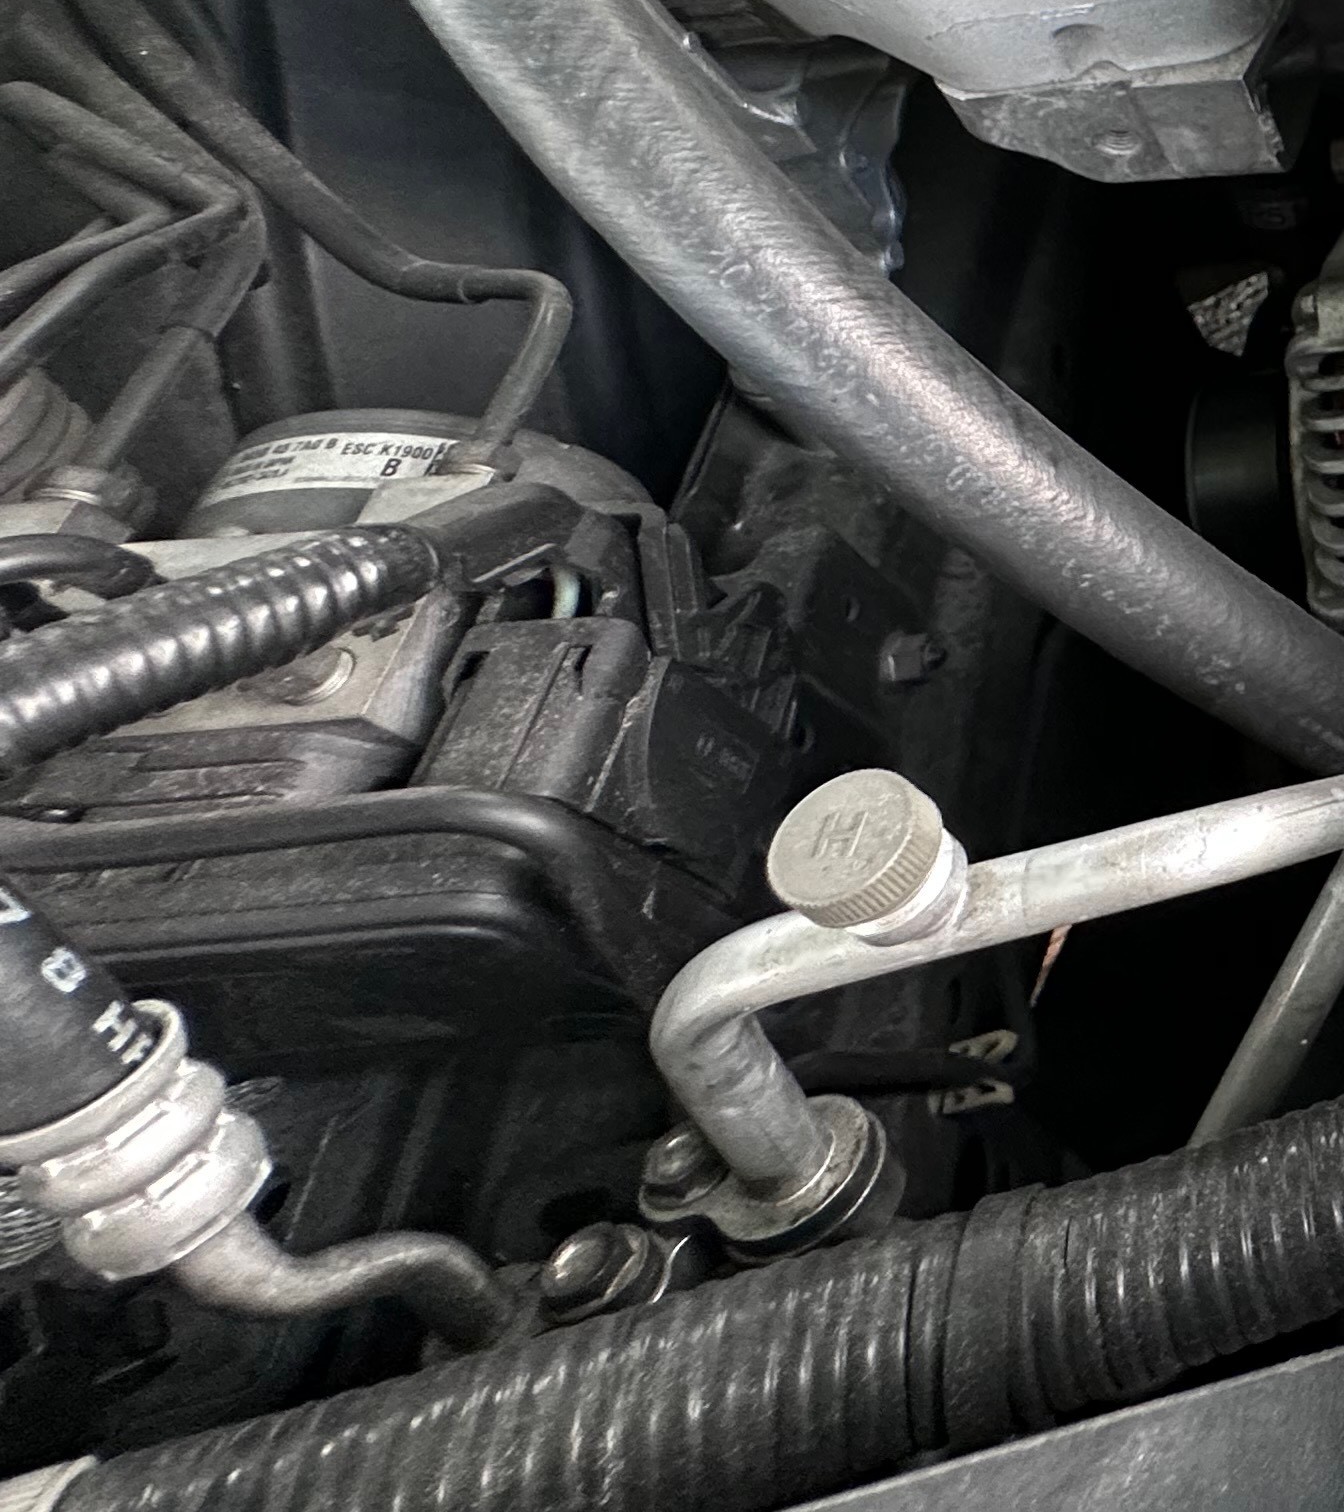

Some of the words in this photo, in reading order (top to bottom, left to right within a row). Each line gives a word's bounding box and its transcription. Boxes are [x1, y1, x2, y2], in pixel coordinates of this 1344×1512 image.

[340, 442, 376, 456] ESC
[379, 457, 403, 477] B
[809, 808, 869, 859] H
